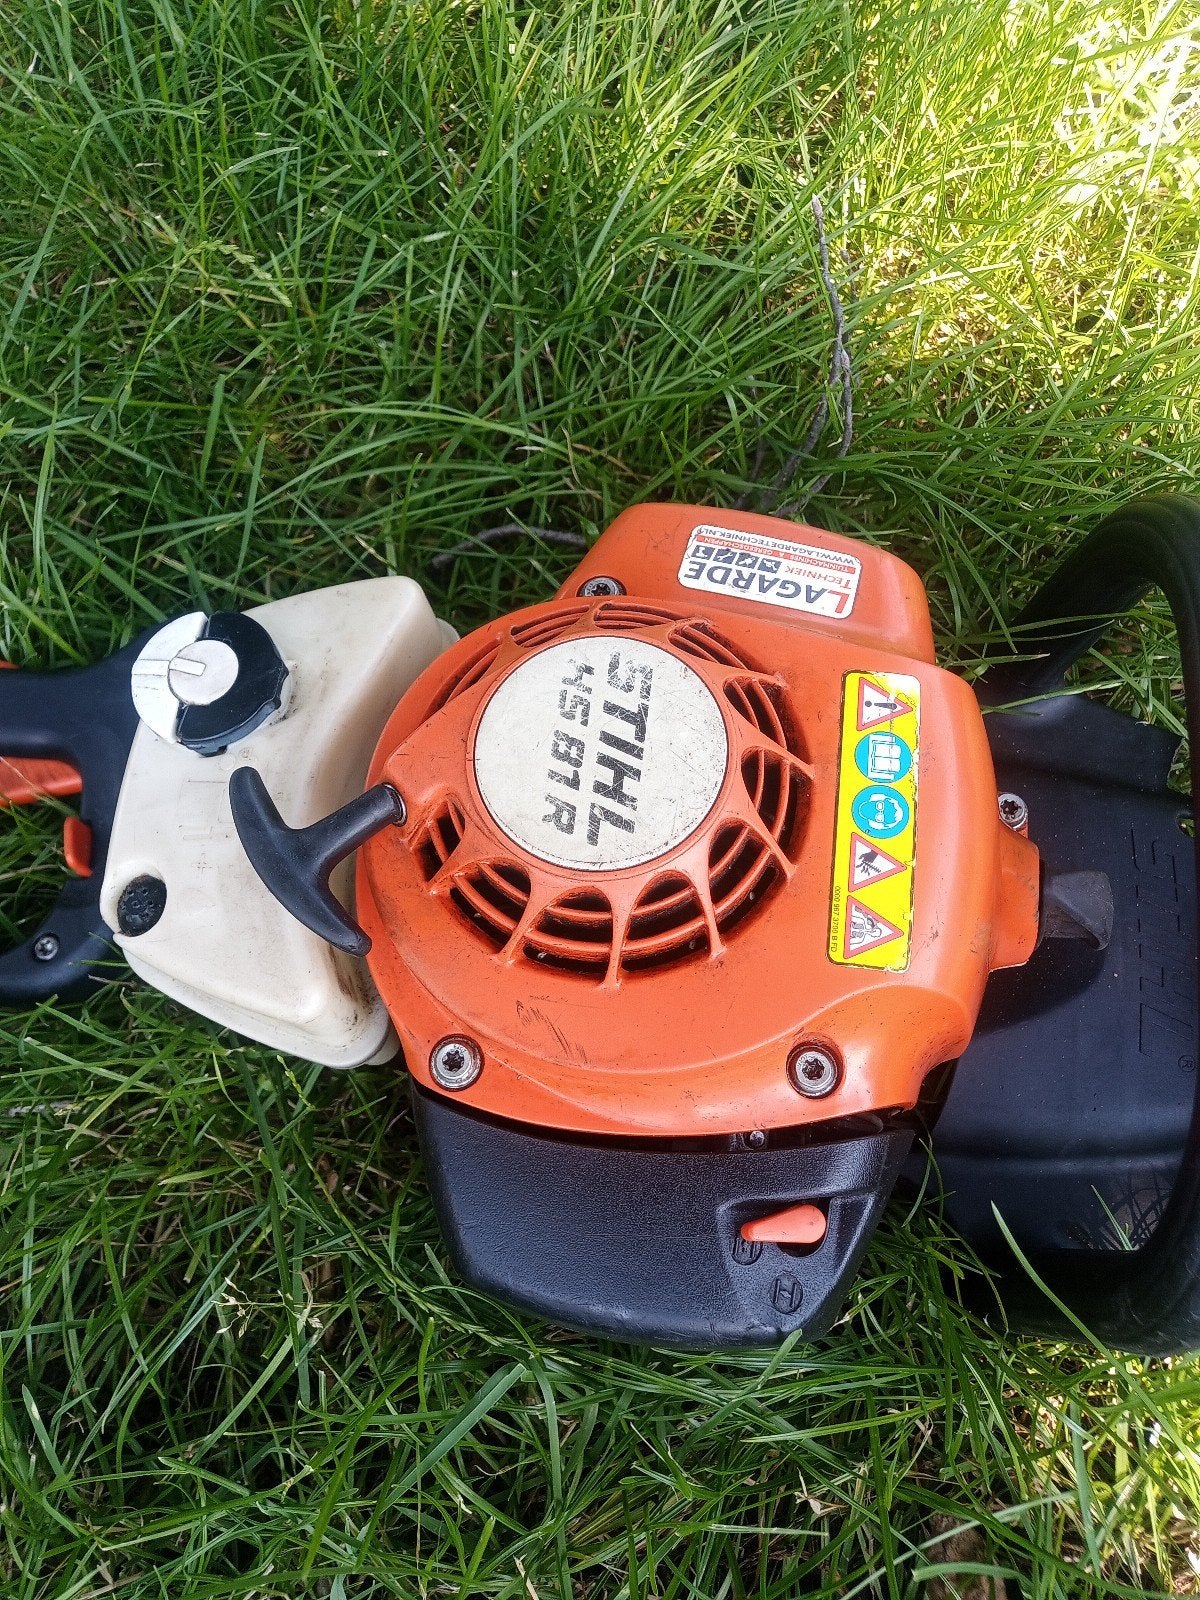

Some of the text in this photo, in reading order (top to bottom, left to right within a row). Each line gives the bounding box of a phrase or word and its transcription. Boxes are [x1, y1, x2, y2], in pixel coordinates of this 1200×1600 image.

[704, 537, 774, 556] GEREEDSCHAPPEN
[789, 553, 850, 573] TUINMACHINES
[684, 560, 850, 614] LAGARDE
[784, 565, 852, 589] TECHNIEK
[542, 658, 595, 835] HS 81 R
[587, 651, 653, 847] STIHL
